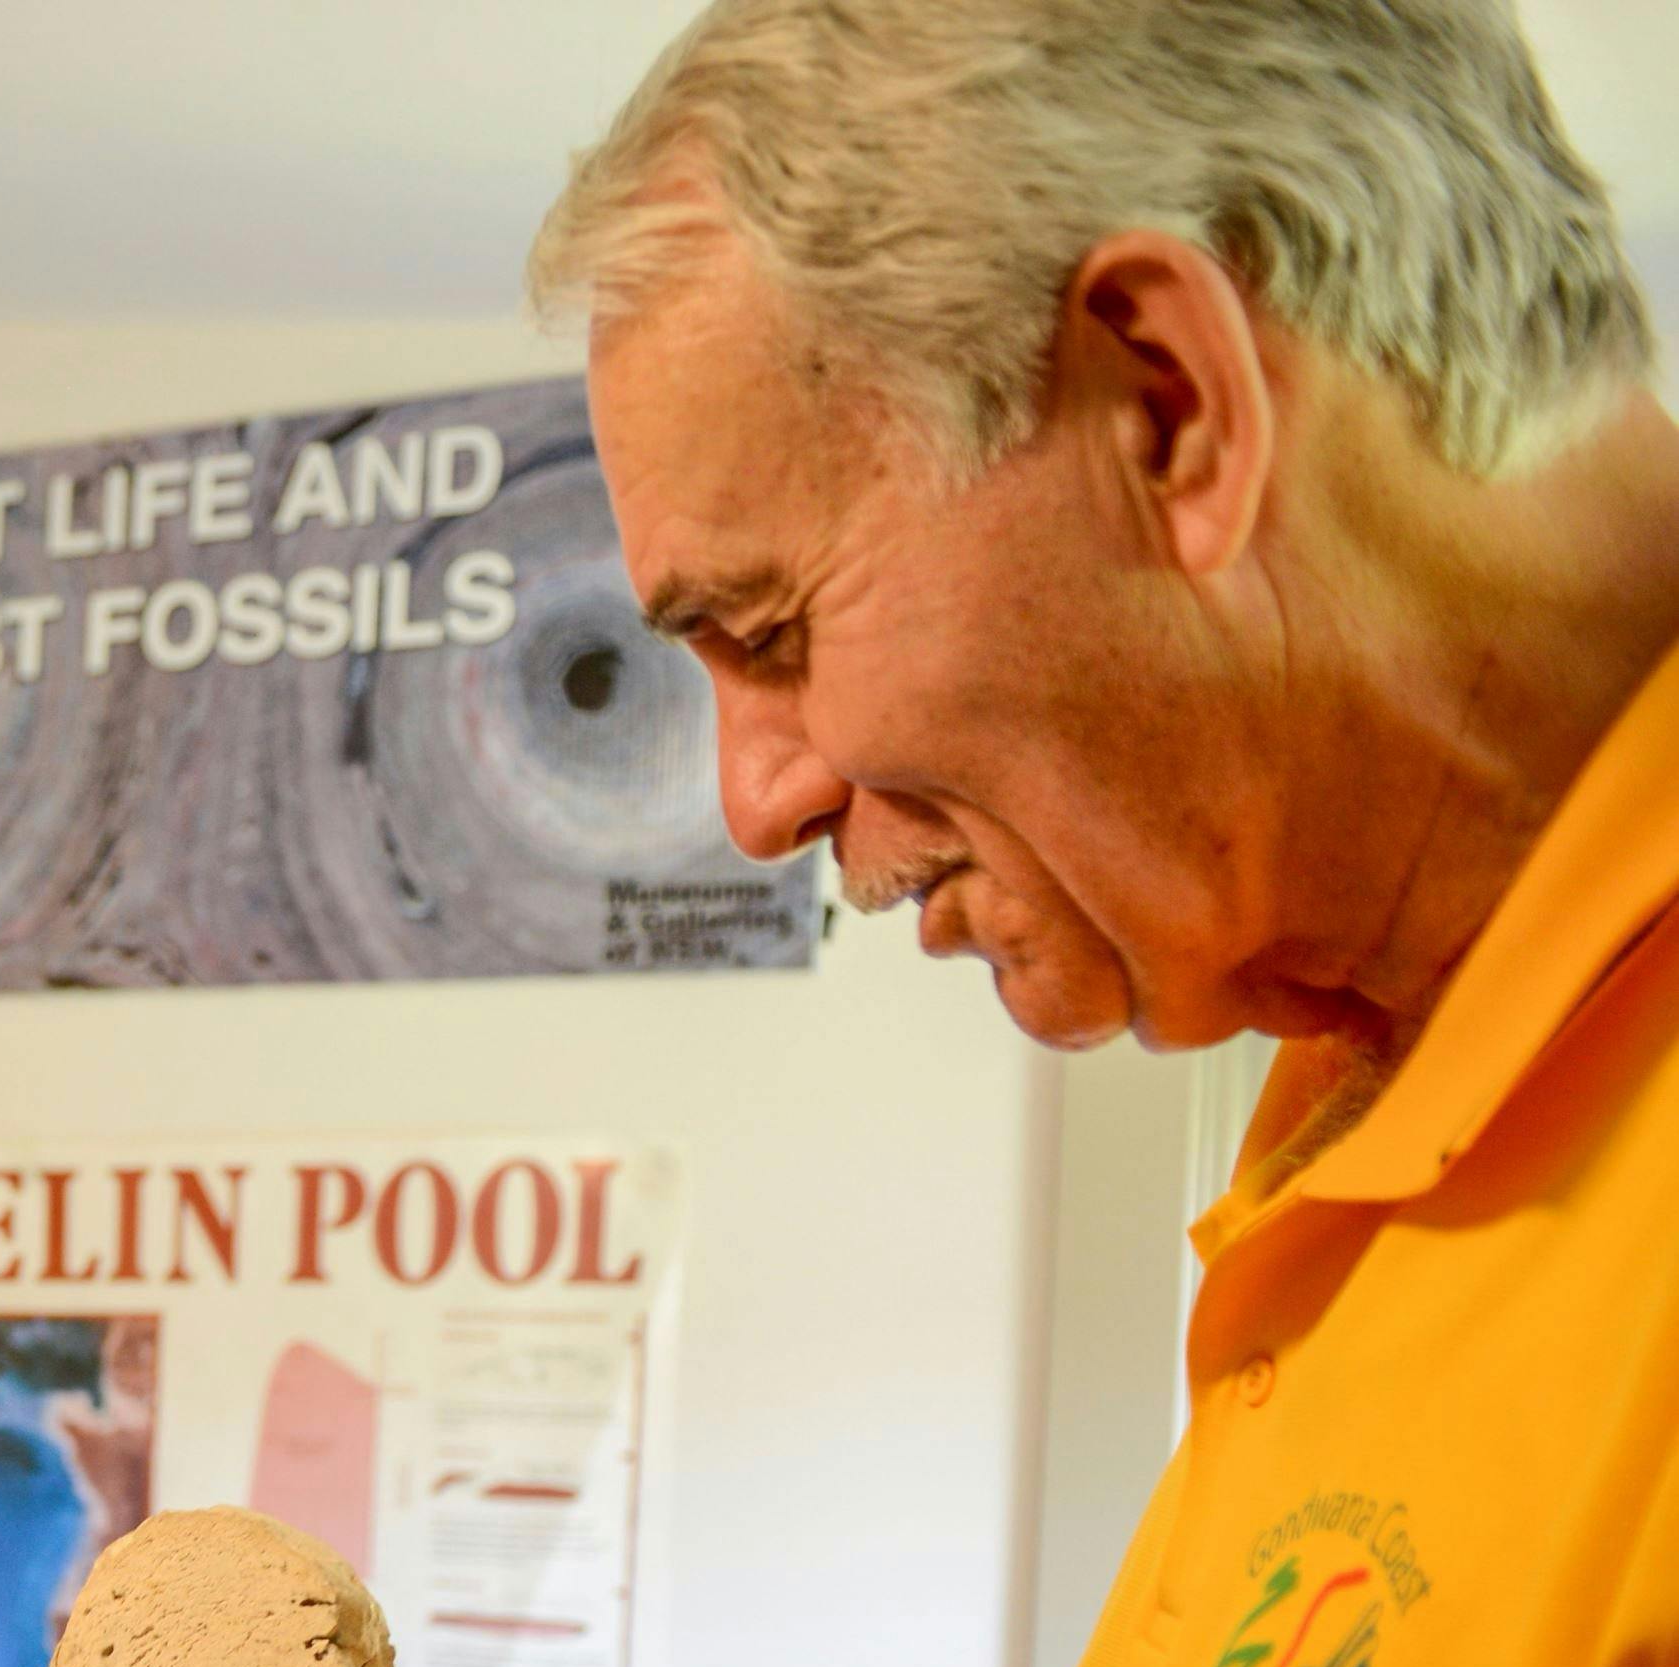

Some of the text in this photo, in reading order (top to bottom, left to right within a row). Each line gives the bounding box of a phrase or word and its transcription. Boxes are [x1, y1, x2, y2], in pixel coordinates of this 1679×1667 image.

[46, 452, 255, 560] LIFE
[272, 424, 505, 535] AND
[82, 549, 518, 678] FOSSILS
[285, 1155, 643, 1288] POOL
